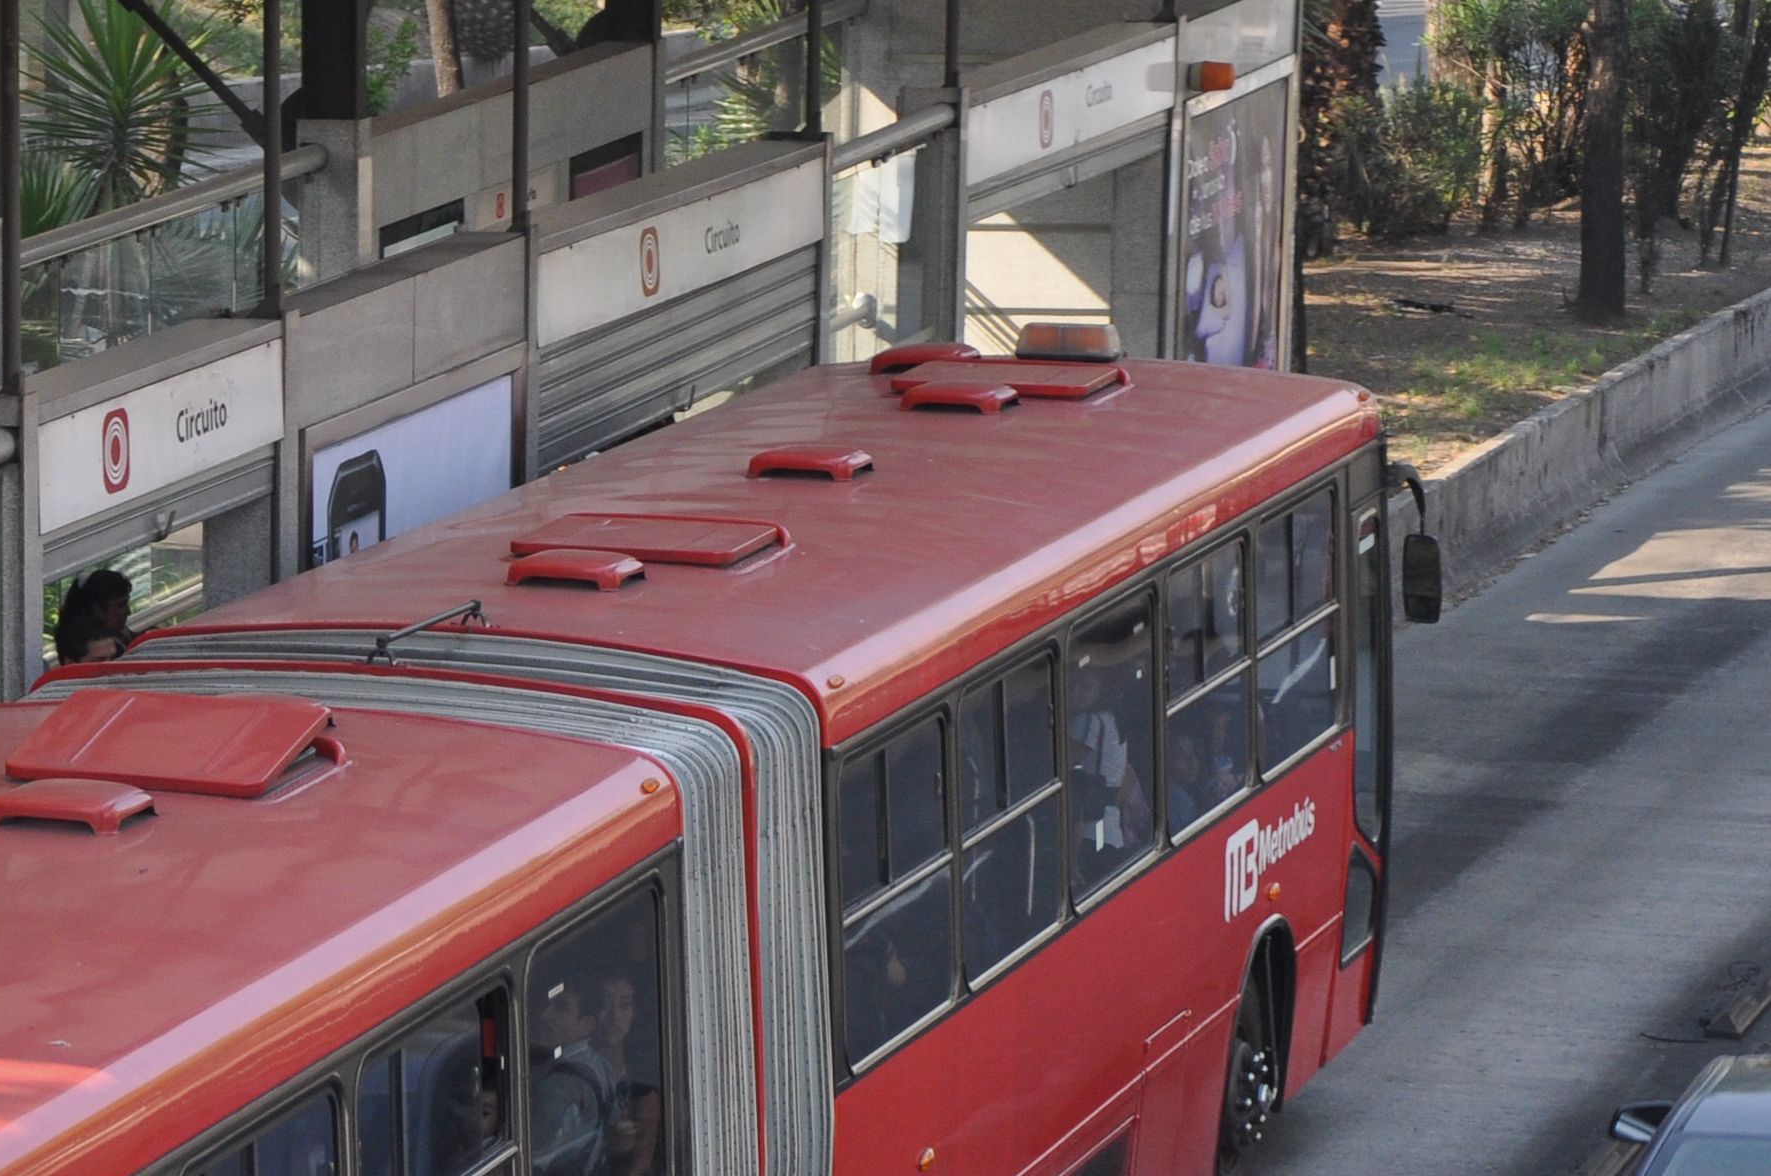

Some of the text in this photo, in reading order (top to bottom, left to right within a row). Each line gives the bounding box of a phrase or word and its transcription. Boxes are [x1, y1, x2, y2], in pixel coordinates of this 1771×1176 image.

[705, 219, 740, 254] Circuito
[177, 399, 227, 443] Circuito
[1224, 795, 1316, 923] MB Metrobús
